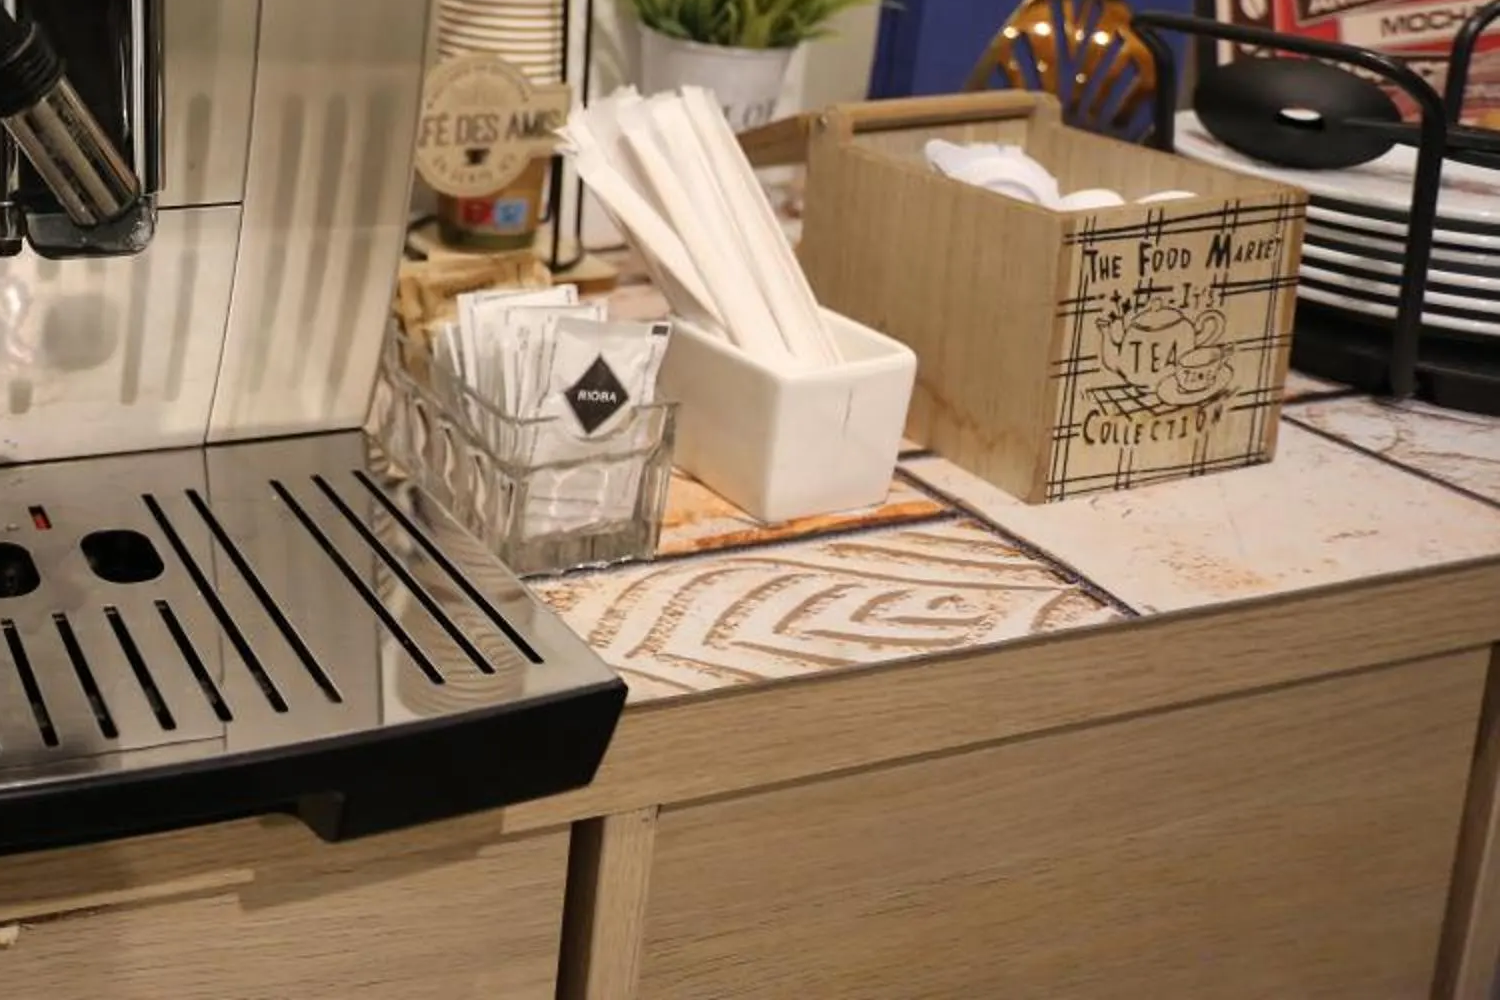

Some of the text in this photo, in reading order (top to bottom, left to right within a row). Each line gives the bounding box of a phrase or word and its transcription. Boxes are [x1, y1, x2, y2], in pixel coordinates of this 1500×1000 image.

[1381, 5, 1480, 38] MOCH
[454, 112, 498, 146] DES
[1082, 233, 1284, 283] THE FOOD MARKET
[1129, 340, 1178, 374] TEA
[1082, 405, 1223, 445] COLLECTION
